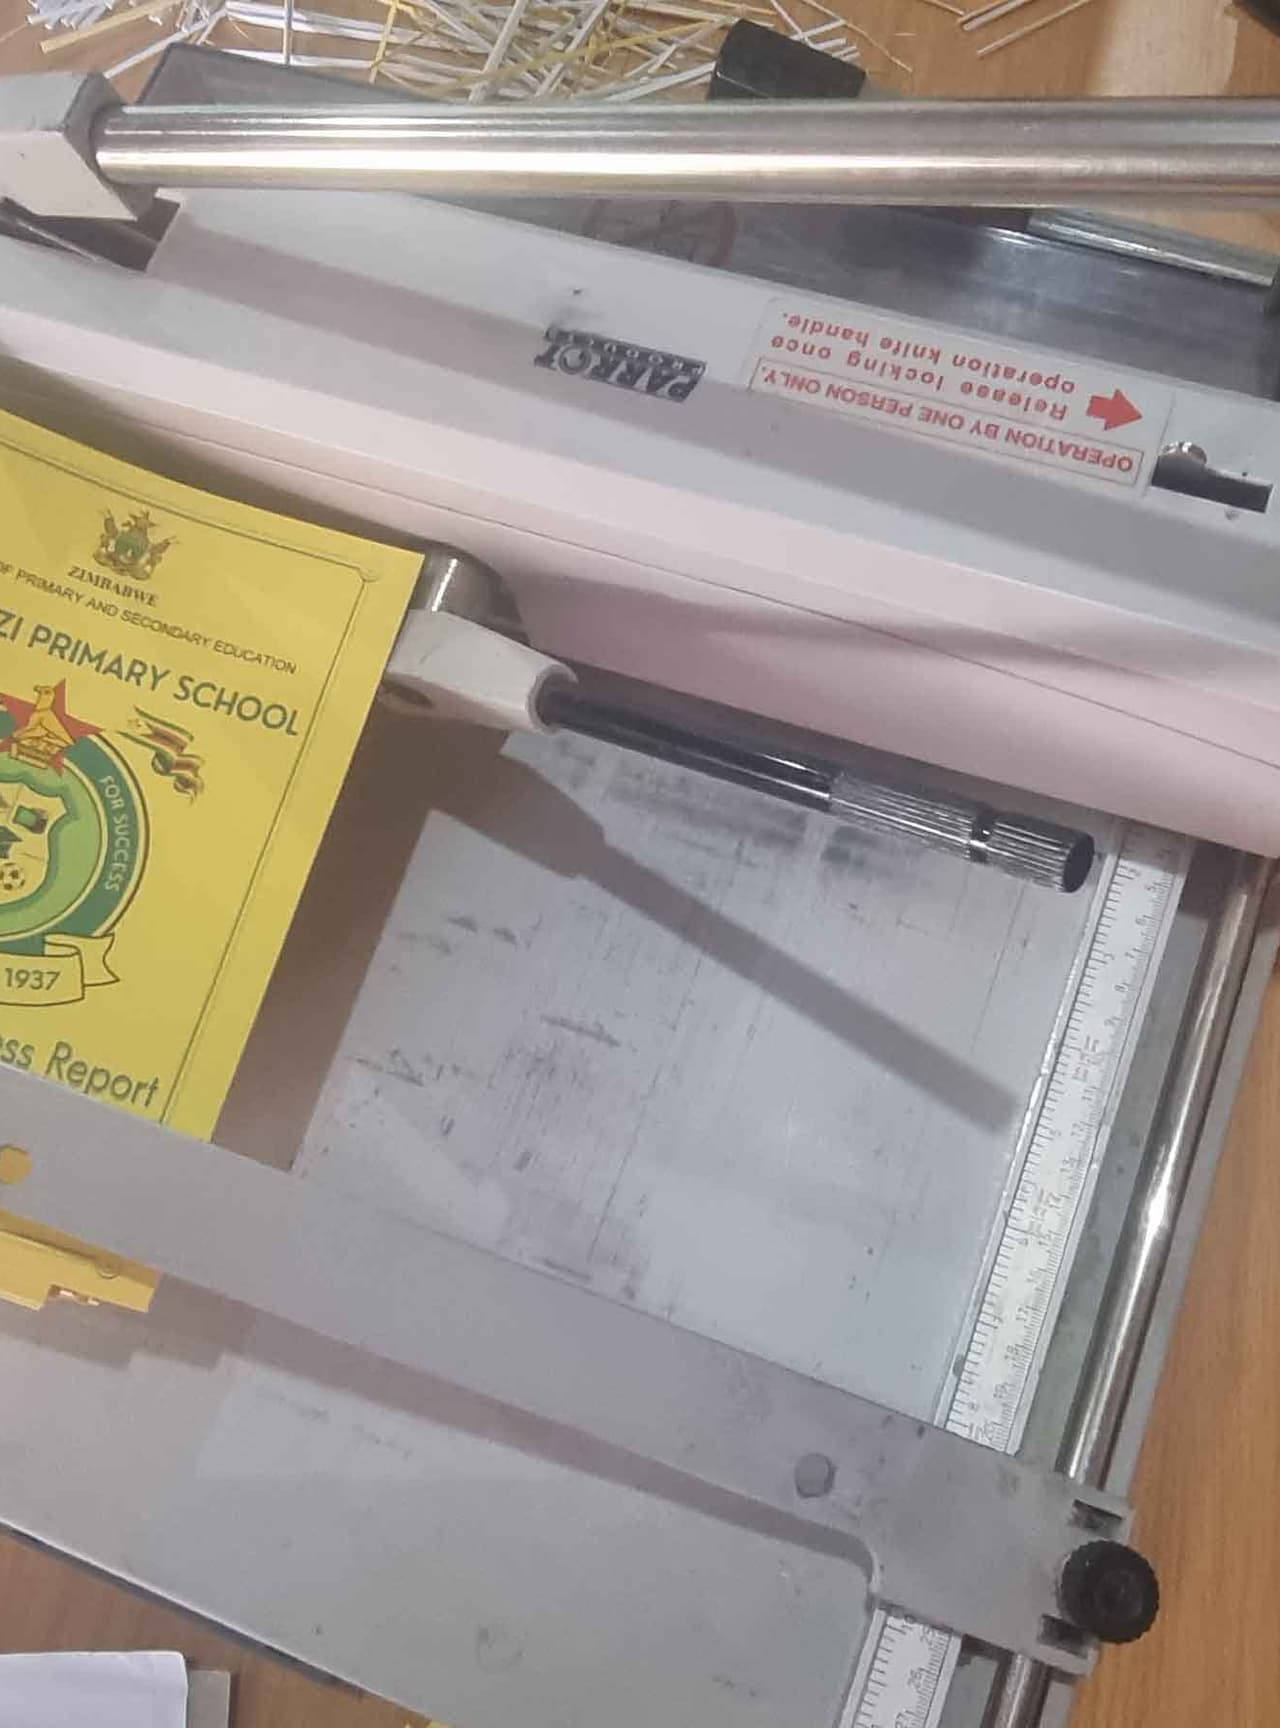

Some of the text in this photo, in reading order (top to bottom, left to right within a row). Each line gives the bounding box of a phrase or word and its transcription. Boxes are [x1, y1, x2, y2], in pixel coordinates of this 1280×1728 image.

[534, 344, 700, 403] PARROT
[771, 335, 1068, 421] Release locking once
[783, 312, 1075, 394] operation knife handle.
[761, 366, 1134, 473] OPERATION BY ONE PERSON ONLY.
[15, 568, 85, 605] PRIMARY
[86, 597, 119, 618] AND
[120, 608, 212, 648] SECONDARY
[213, 639, 297, 675] EDUCATION
[67, 565, 160, 608] ZIMBABWE
[27, 623, 171, 691] PRIMARY
[173, 675, 299, 736] SCHOOL
[99, 775, 131, 892] FOR SUCCESS
[4, 966, 61, 992] 1937
[44, 1040, 160, 1108] Report
